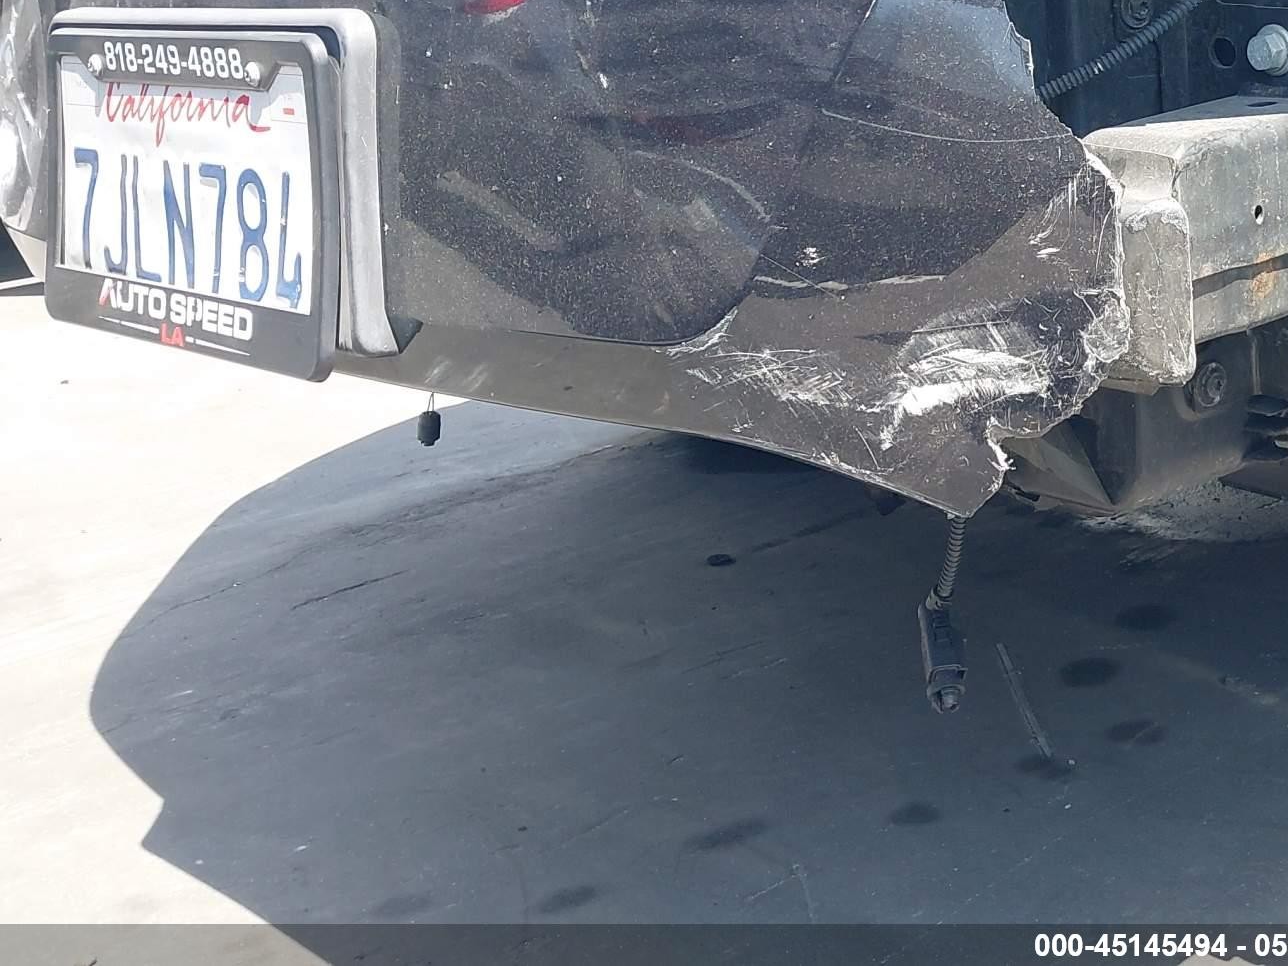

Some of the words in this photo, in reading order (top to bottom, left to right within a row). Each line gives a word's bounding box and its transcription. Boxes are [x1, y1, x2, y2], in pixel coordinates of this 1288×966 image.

[103, 41, 244, 80] 818-249-4888
[103, 82, 271, 147] California
[73, 146, 302, 309] 7JLN784
[99, 280, 166, 321] AUTO
[169, 293, 254, 341] SPEED
[159, 323, 184, 346] LA
